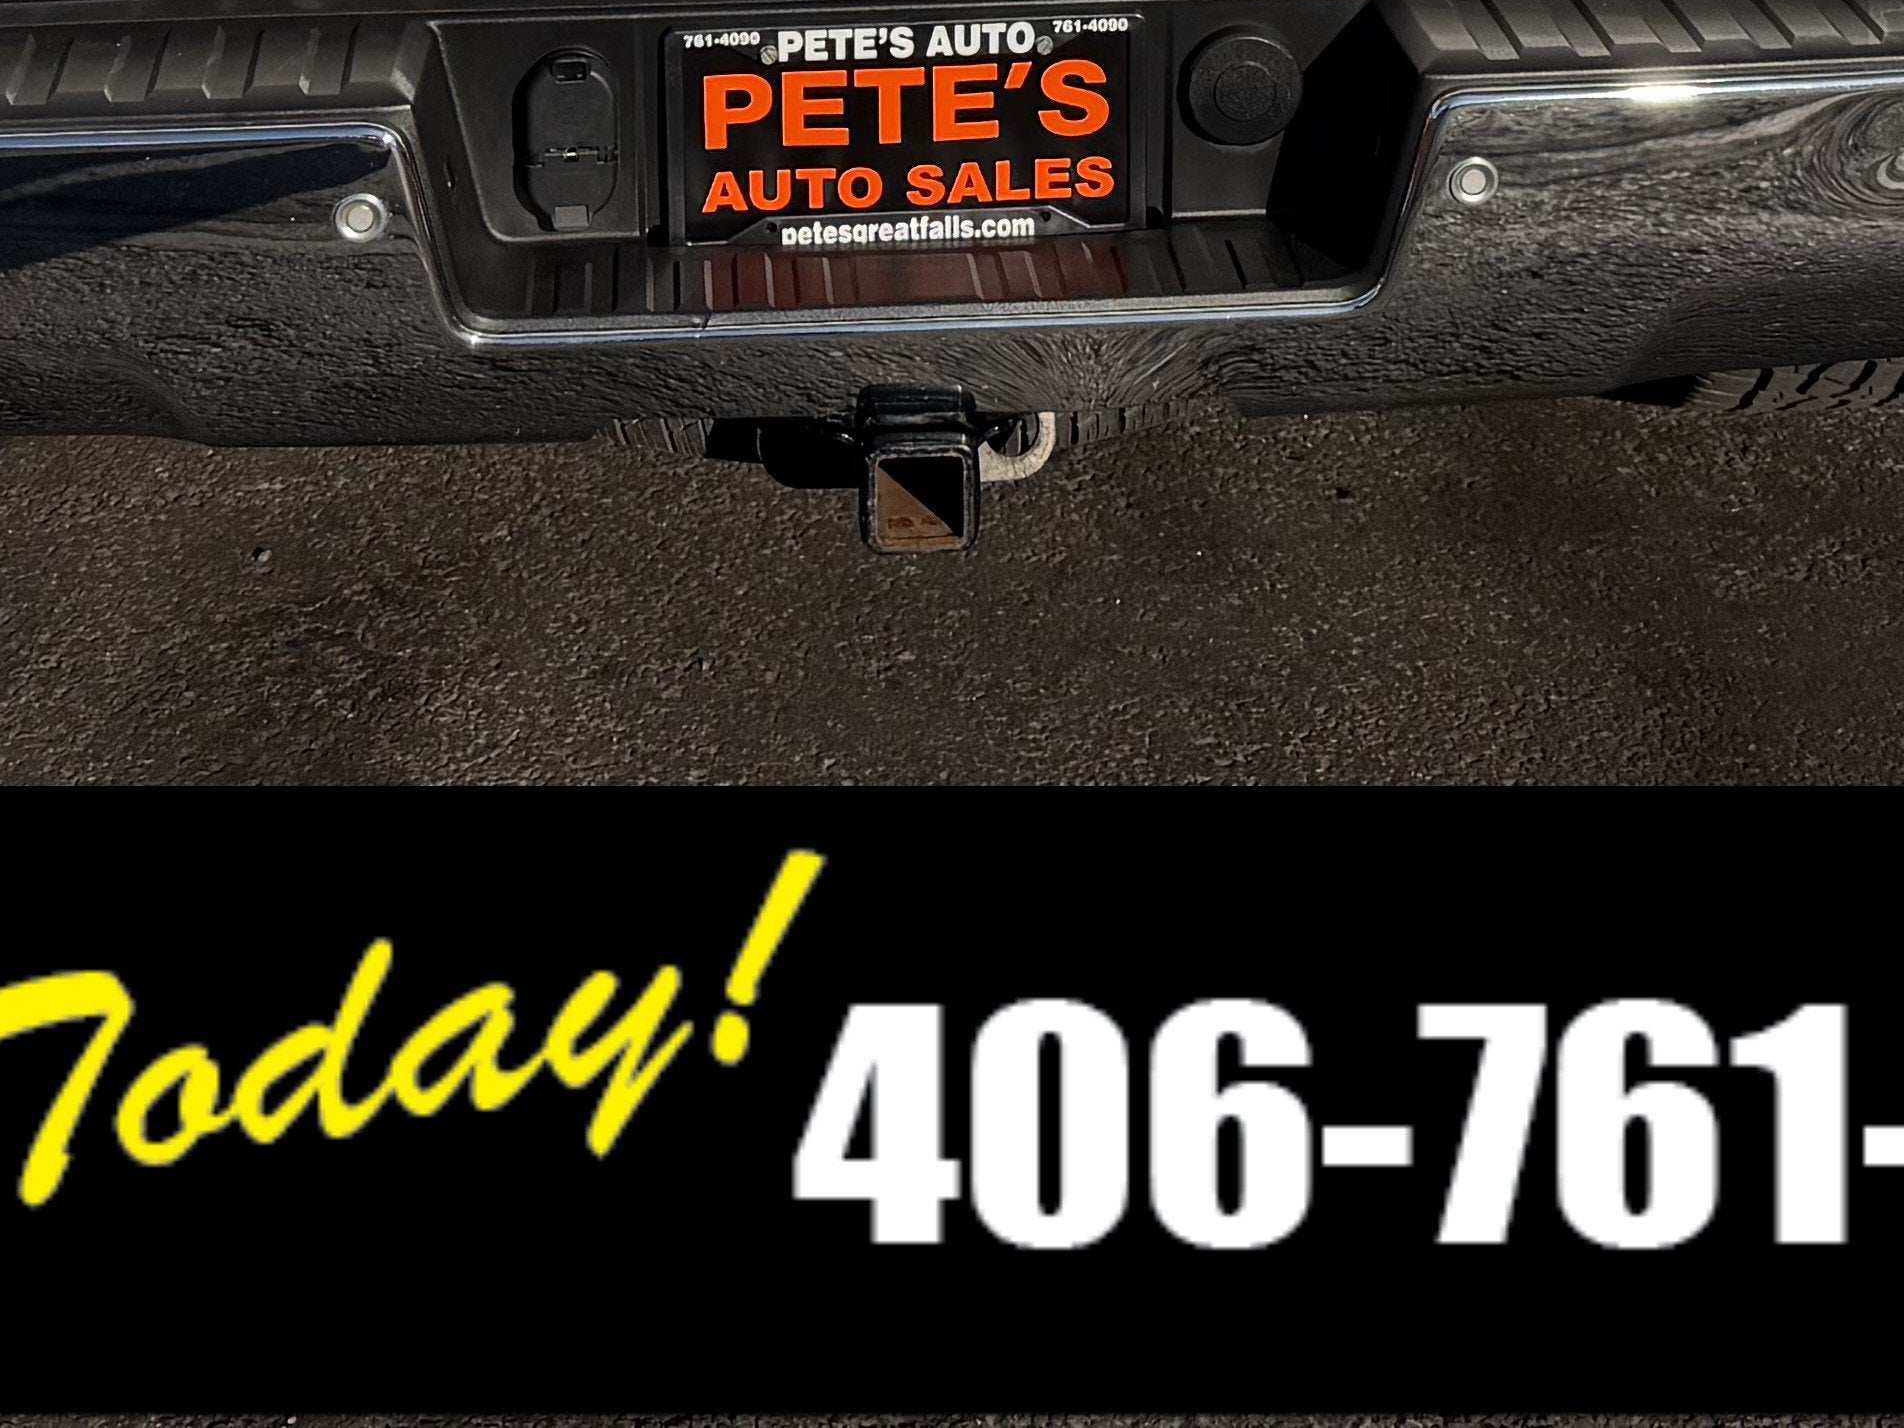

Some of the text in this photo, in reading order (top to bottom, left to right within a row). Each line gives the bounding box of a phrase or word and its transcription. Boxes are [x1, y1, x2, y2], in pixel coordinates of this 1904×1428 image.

[777, 22, 1035, 62] PETE'S AUTO
[704, 59, 1110, 150] PETE'S
[702, 156, 1115, 213] AUTO SALES
[781, 214, 1035, 245] petesgreatfalls.com
